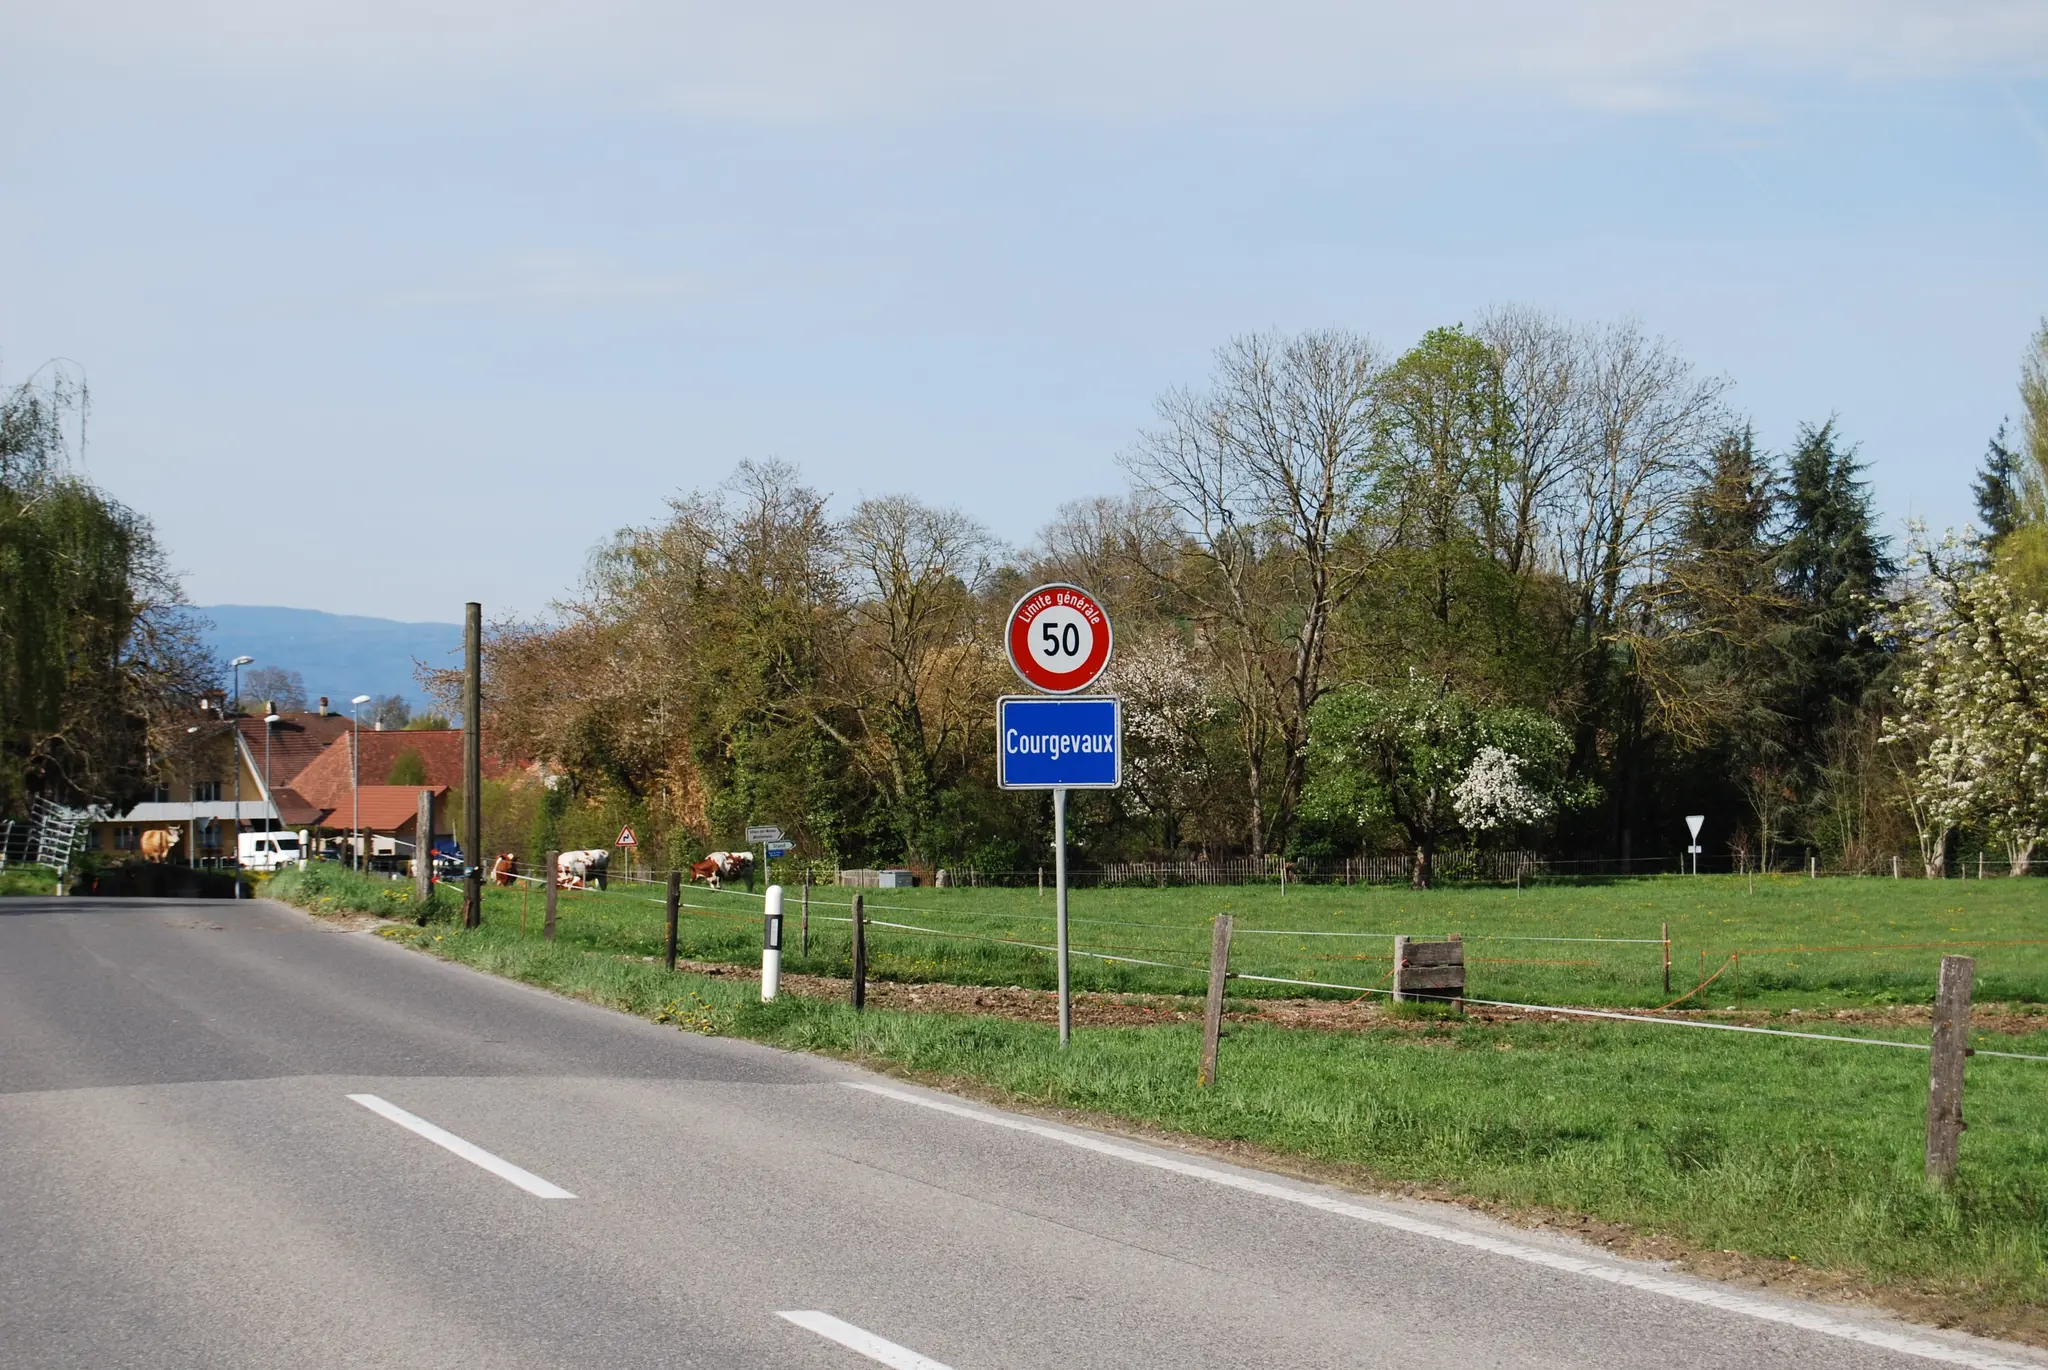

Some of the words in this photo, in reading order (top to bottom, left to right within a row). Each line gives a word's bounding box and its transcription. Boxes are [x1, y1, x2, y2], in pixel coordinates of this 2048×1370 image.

[1018, 595, 1052, 624] Limite
[1057, 591, 1100, 625] générale
[1042, 622, 1080, 657] 50
[1006, 728, 1114, 761] Courgevaux
